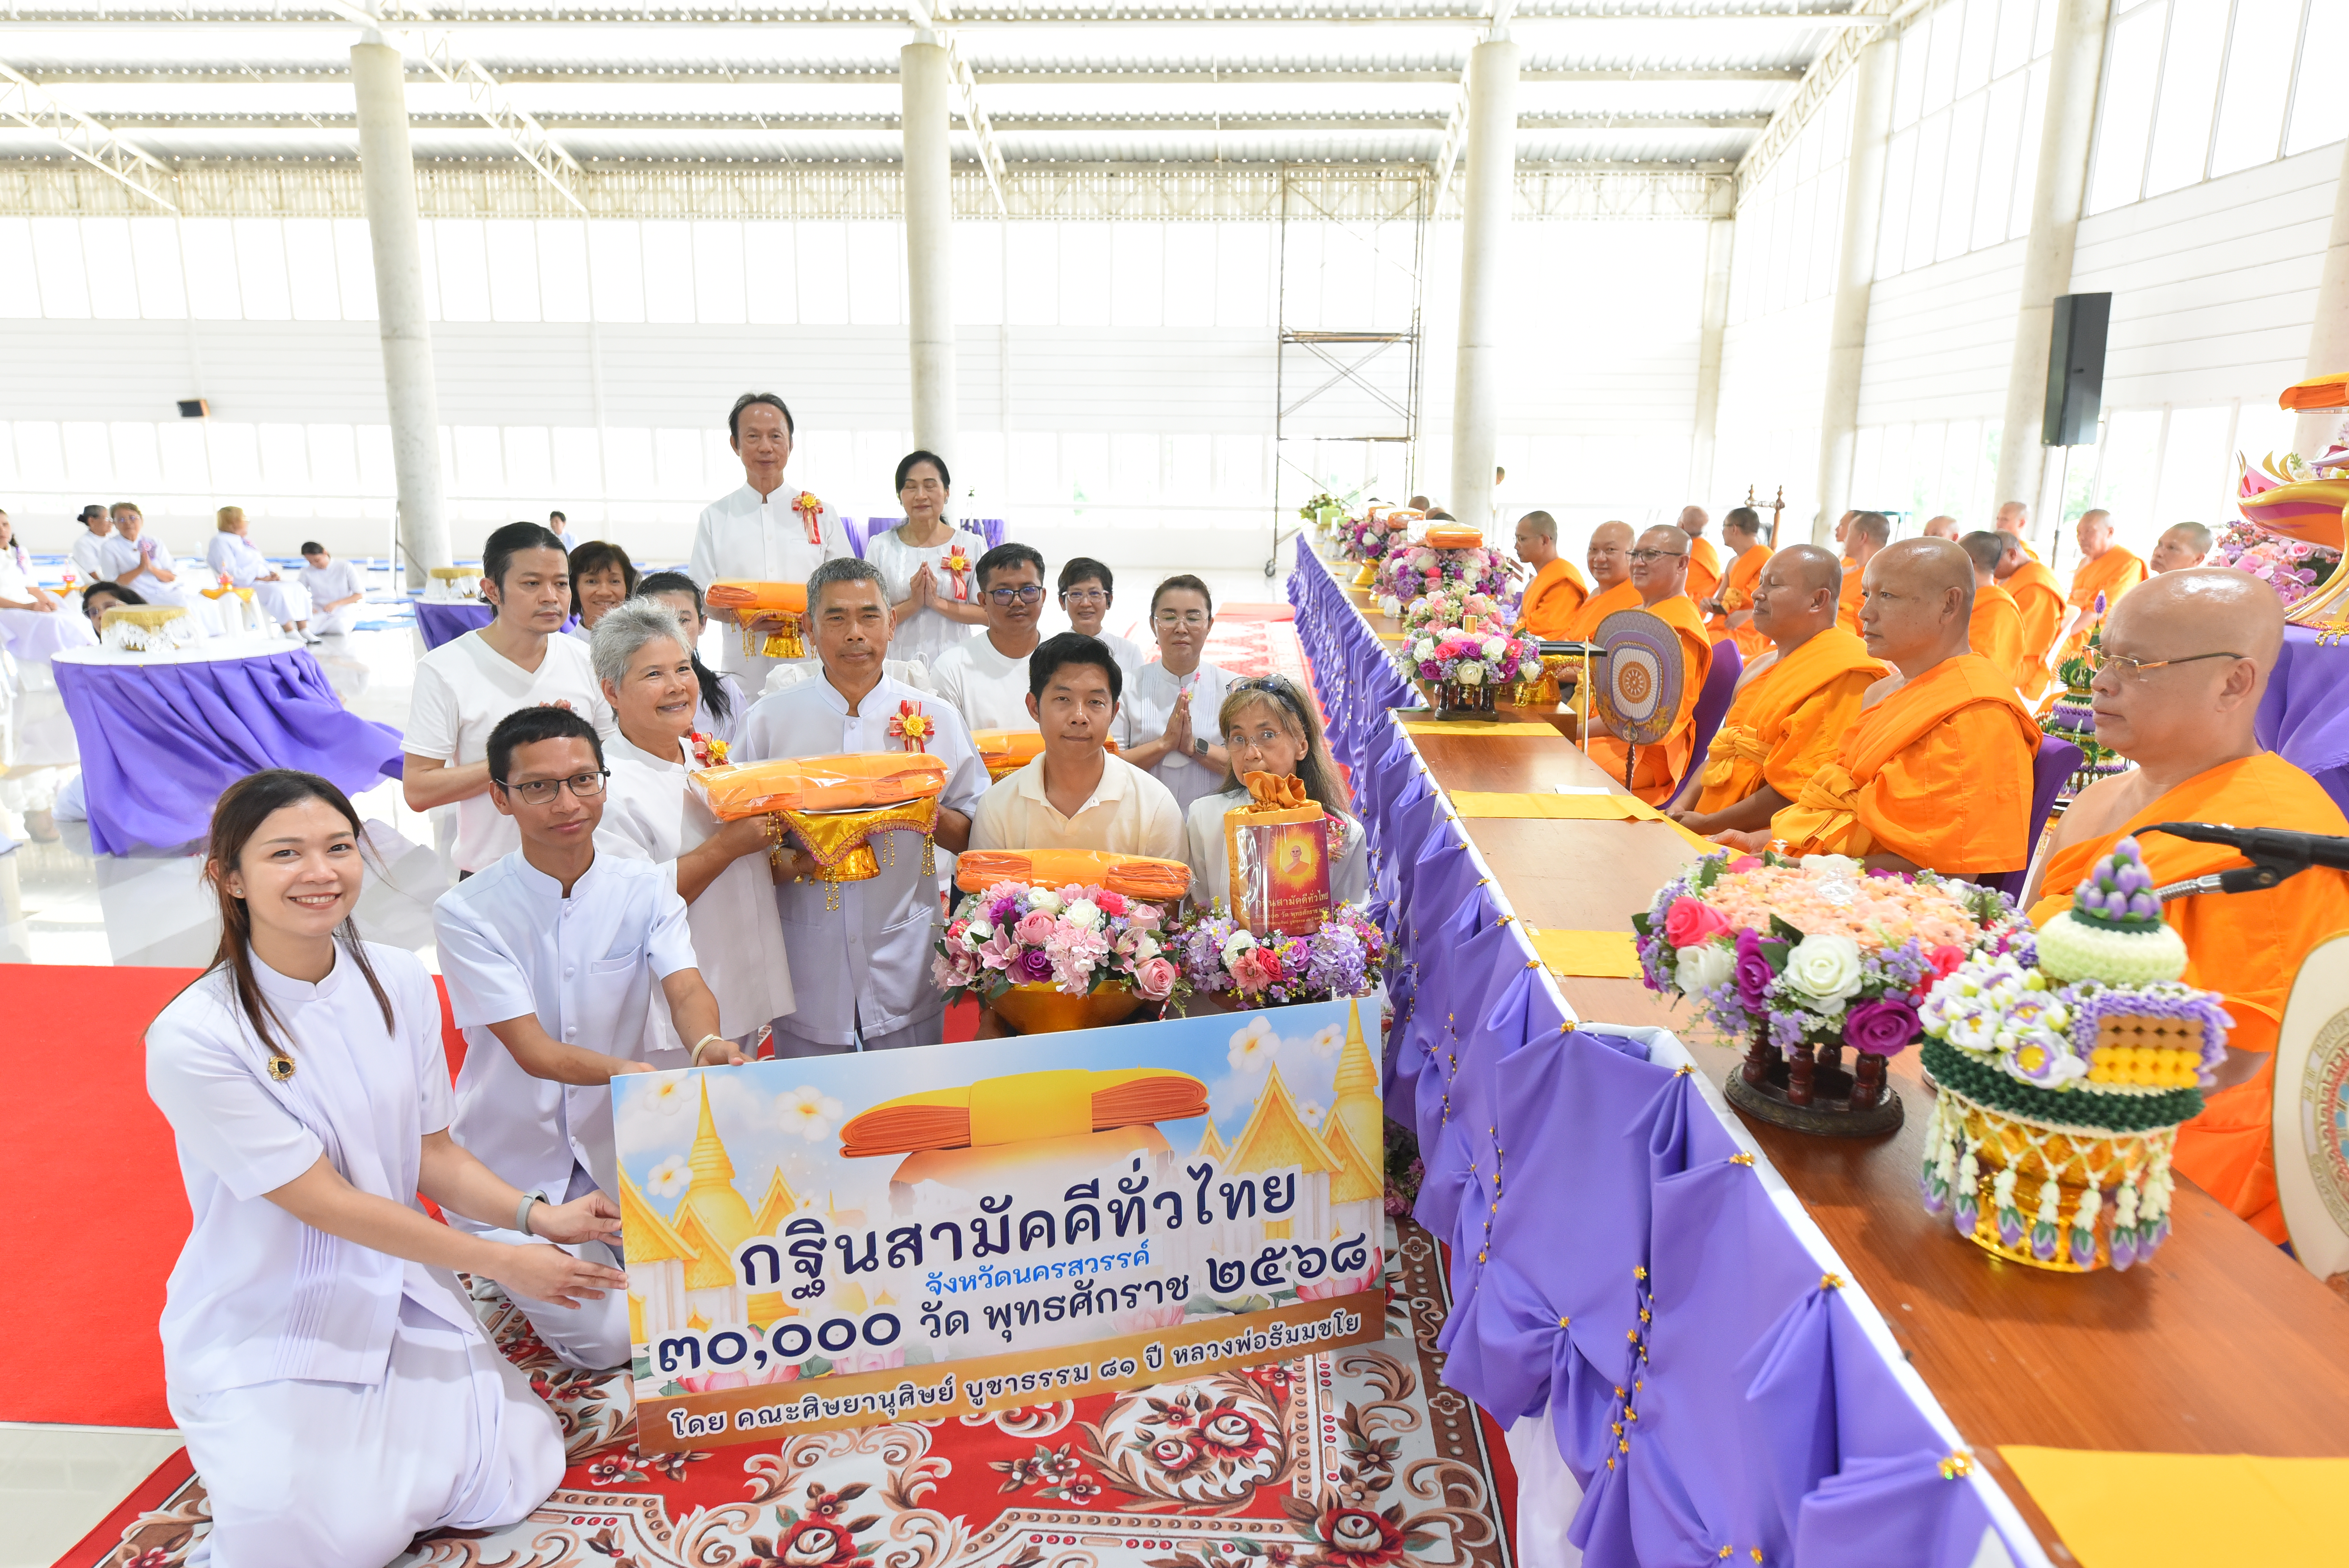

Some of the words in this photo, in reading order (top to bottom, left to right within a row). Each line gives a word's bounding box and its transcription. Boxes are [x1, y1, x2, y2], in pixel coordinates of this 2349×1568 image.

[1255, 889, 1329, 910] กนสามัคคีทั่วไทย
[1290, 909, 1318, 918] พุทธศักราช
[740, 1157, 1295, 1299] กฐินสามัคคีทั่วไทย
[925, 1239, 1149, 1295] จังหวัดนครสวรรค์
[659, 1313, 901, 1372] ๓๐,๐๐๐
[920, 1301, 970, 1338] วัด
[983, 1279, 1189, 1343] พุทธศักราช
[1206, 1232, 1367, 1294] ๒๕๖๘
[670, 1411, 724, 1435] โดย
[738, 1376, 953, 1427] คณะศิษยานุศิษย์
[968, 1365, 1088, 1406] บูชาธรรม
[1100, 1360, 1135, 1377] ๘๑
[1146, 1343, 1162, 1368] ปี
[1173, 1311, 1359, 1364] หลวงพ่อธัมมชโย
